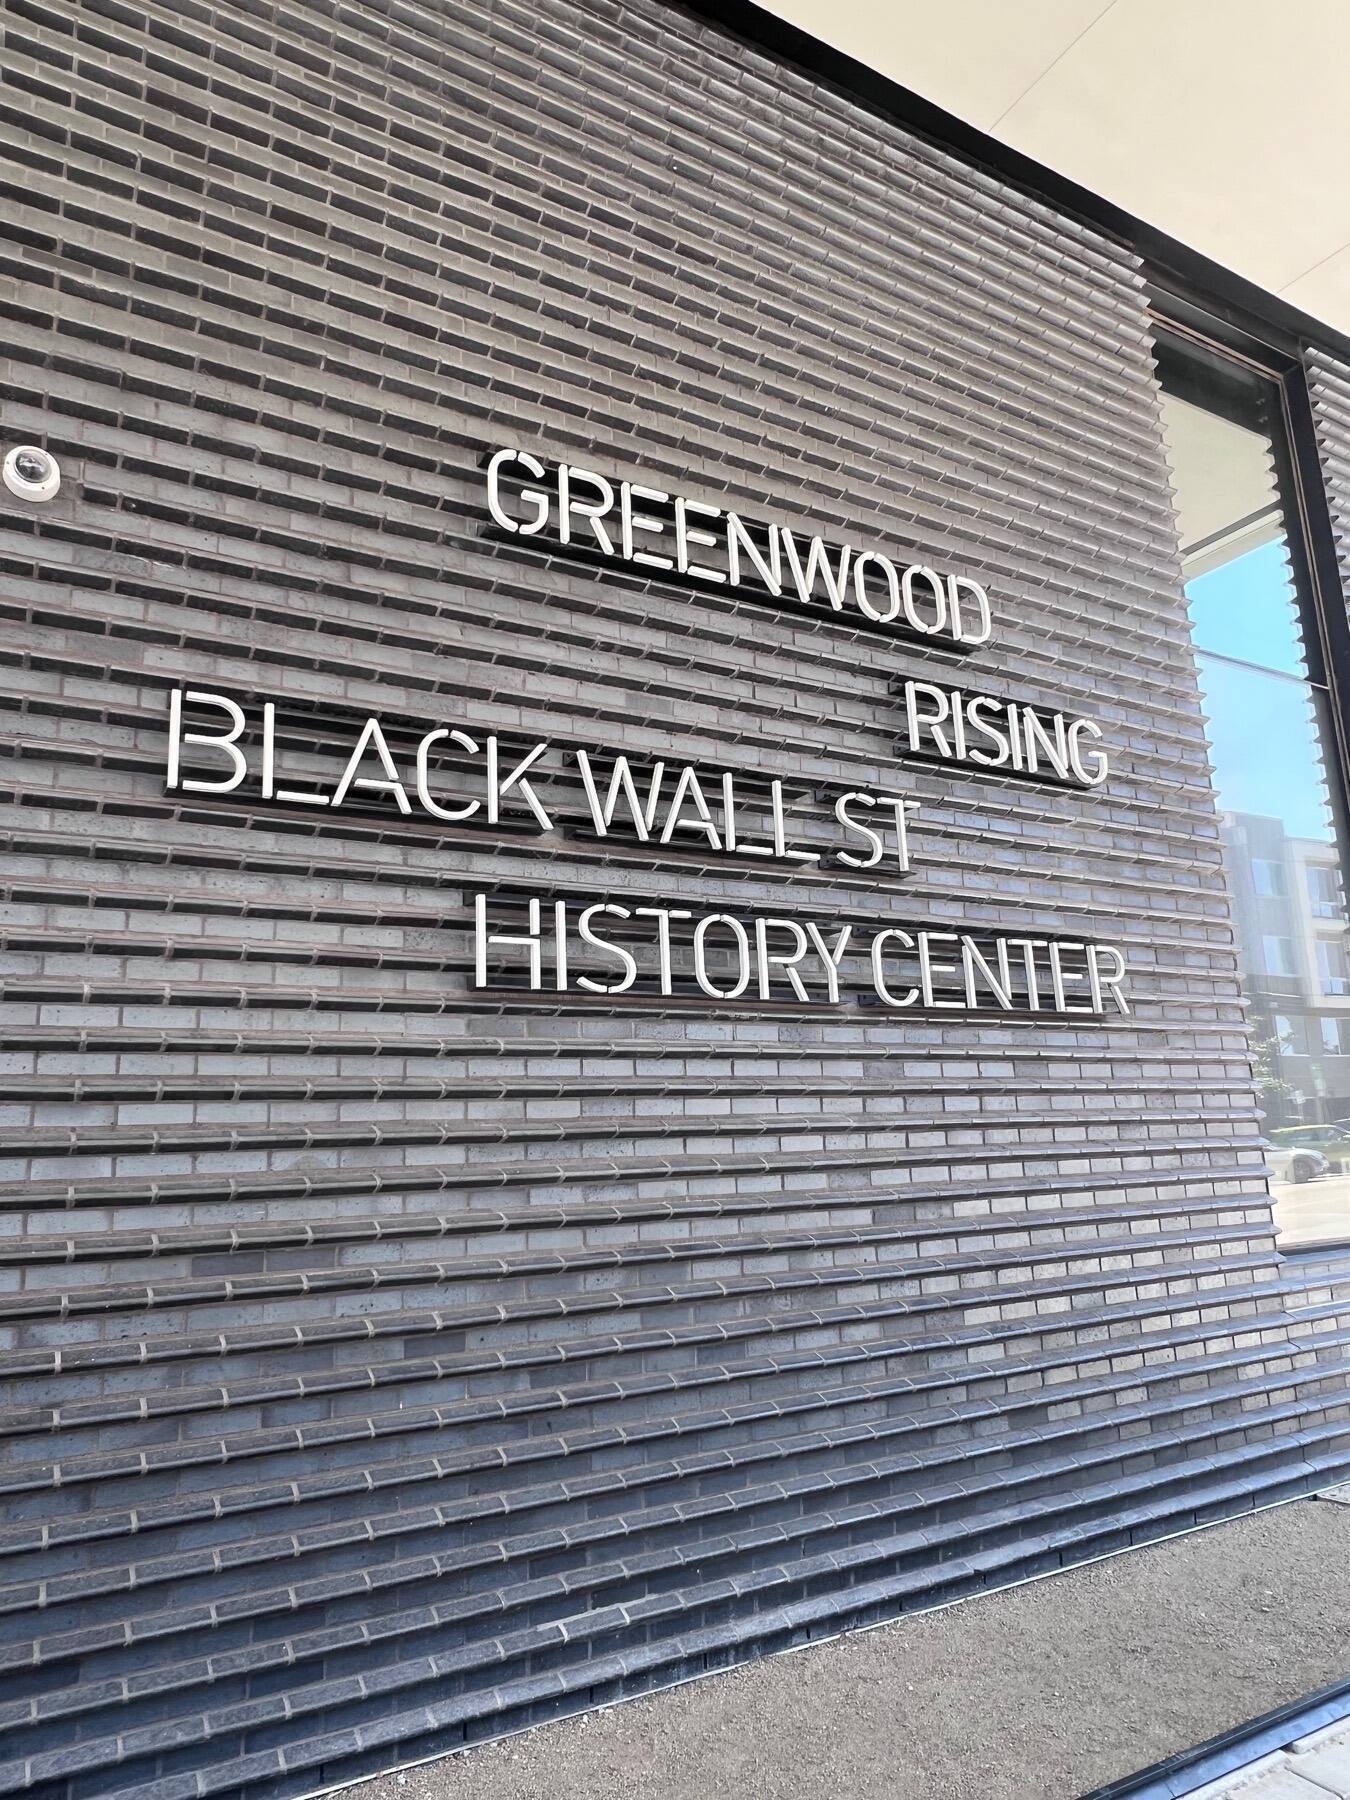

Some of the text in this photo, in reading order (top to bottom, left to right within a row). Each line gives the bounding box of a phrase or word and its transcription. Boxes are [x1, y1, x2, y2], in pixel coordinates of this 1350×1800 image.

[486, 448, 992, 646] GREENWOOD
[166, 688, 920, 874] BLACK WALL ST
[904, 680, 1109, 786] RISING
[474, 892, 1131, 1017] HISTORY CENTER
